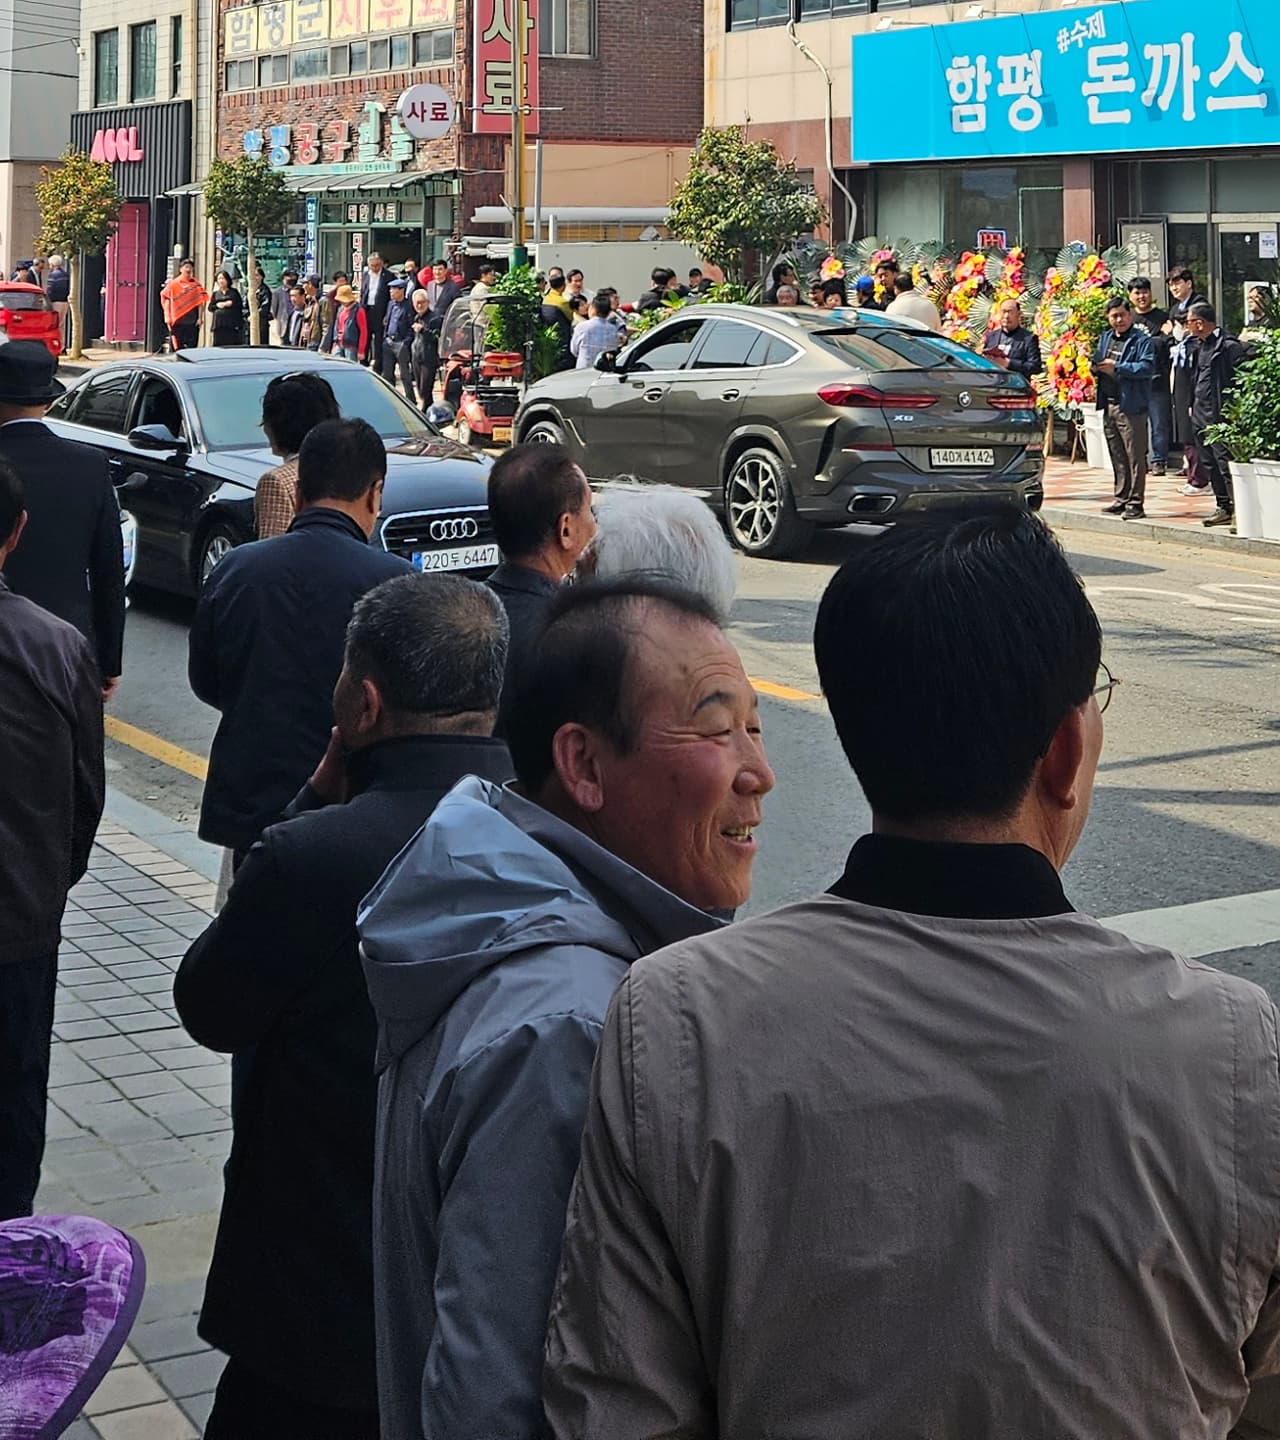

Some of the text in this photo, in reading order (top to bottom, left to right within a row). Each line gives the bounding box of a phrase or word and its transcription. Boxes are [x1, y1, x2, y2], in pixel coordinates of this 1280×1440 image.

[1056, 10, 1107, 54] #수제
[946, 49, 1044, 134] 함평
[1082, 32, 1268, 126] 돈까스
[406, 101, 450, 123] 사료
[463, 547, 495, 566] 6447
